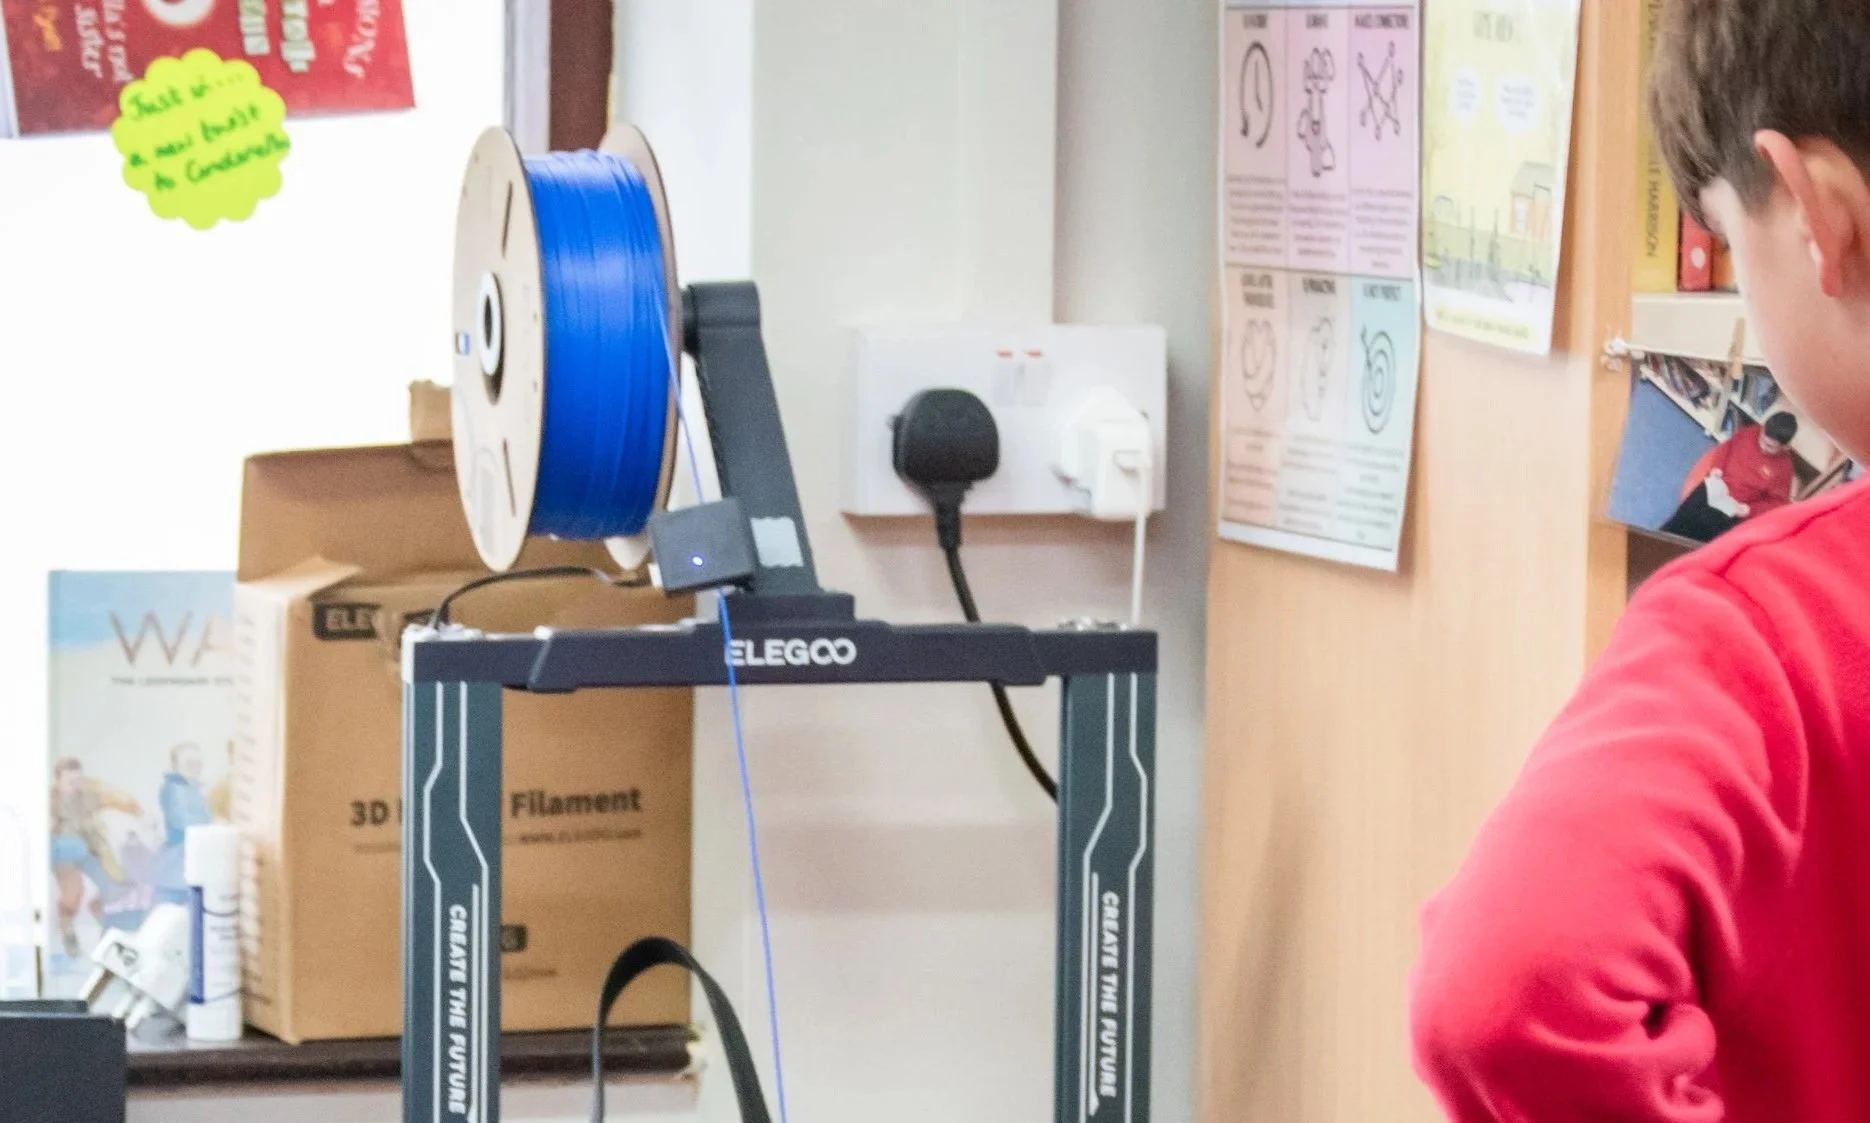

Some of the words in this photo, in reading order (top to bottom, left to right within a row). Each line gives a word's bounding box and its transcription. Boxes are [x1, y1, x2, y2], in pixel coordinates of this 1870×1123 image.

[128, 85, 183, 120] Just
[129, 153, 148, 168] a
[155, 132, 193, 158] new
[154, 171, 176, 191] to
[1645, 180, 1660, 257] HARRISON
[725, 637, 857, 666] ELEGOO
[350, 799, 390, 827] 3D
[510, 787, 642, 818] Filament
[449, 904, 468, 983] CREATE
[1101, 890, 1120, 968] CREATE
[448, 987, 467, 1029] THE
[1101, 973, 1119, 1014] THE
[448, 1033, 467, 1115] FUTURE
[1099, 1018, 1118, 1098] FUTURE
